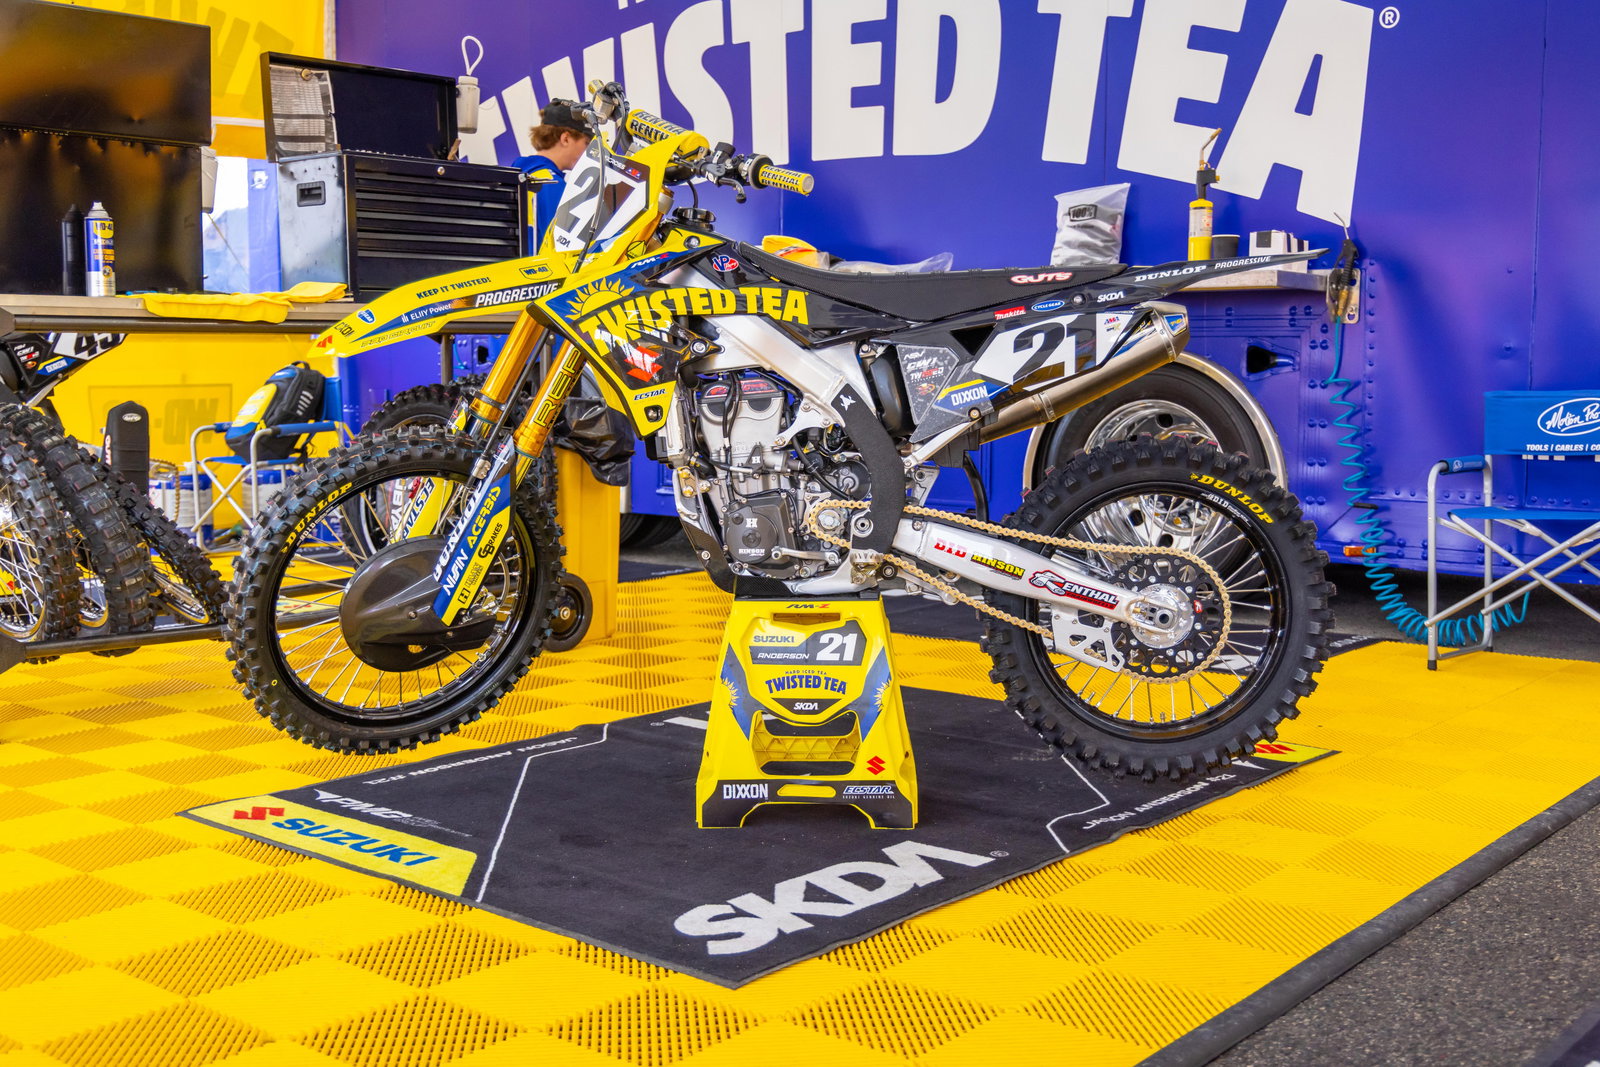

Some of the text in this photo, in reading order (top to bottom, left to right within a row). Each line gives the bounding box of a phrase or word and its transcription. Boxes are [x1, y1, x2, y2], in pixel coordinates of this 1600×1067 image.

[633, 111, 688, 135] RENTHA
[1041, 0, 1374, 228] TEA
[631, 119, 670, 142] RENTH
[761, 171, 800, 186] RENTHAL
[523, 266, 549, 276] WD-40
[713, 255, 730, 271] VP
[1214, 255, 1272, 270] PROGRESSIVE
[1011, 271, 1073, 284] GUTS
[1134, 265, 1207, 282] DUNLOP
[416, 277, 492, 300] KEEP IT TWISTED!
[475, 282, 559, 308] PROGRESSIVE
[1097, 291, 1125, 303] SKDA
[430, 303, 452, 315] Power
[579, 286, 810, 357] TWISTED TEA
[1012, 313, 1098, 390] 21
[634, 388, 666, 401] ECSTAR
[951, 385, 988, 406] DIXXON
[1545, 405, 1584, 430] Motion
[1197, 474, 1274, 524] DUNLOP
[285, 482, 353, 546] DUNLOP
[466, 486, 502, 549] ACERBIS
[753, 635, 795, 643] SUZUKI
[816, 632, 858, 661] 21
[757, 652, 810, 660] ANDERSON
[765, 674, 848, 695] TWISTED TEA
[793, 702, 819, 711] SKDA
[516, 736, 579, 753] JASON
[408, 750, 513, 777] ANDERSON
[723, 784, 768, 799] DIXXON
[843, 785, 894, 795] ECSTAR
[1134, 781, 1210, 813] ANDERSON
[272, 817, 440, 868] SUZUKI
[673, 839, 996, 957] SKDA
